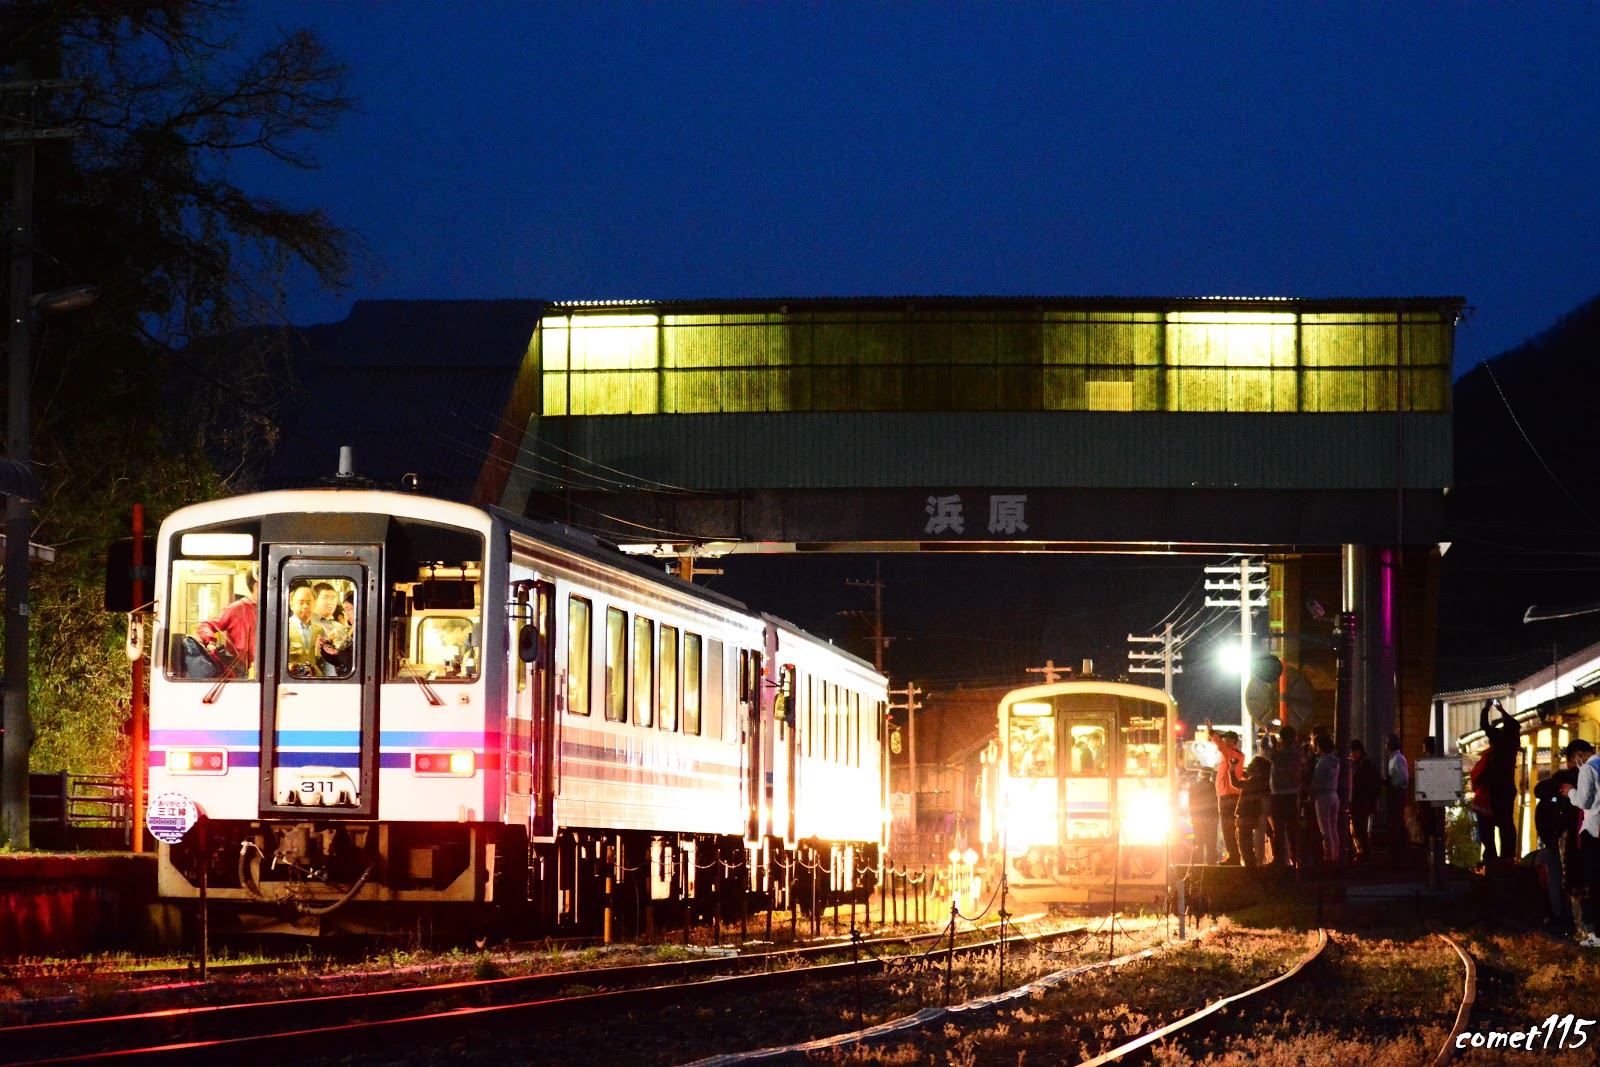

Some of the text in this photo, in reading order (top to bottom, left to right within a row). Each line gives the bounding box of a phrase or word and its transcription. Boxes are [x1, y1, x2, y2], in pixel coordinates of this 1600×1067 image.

[924, 494, 1029, 534] 浜原
[301, 781, 333, 793] 311
[158, 800, 187, 808] ありがとう
[157, 807, 186, 816] 三江線
